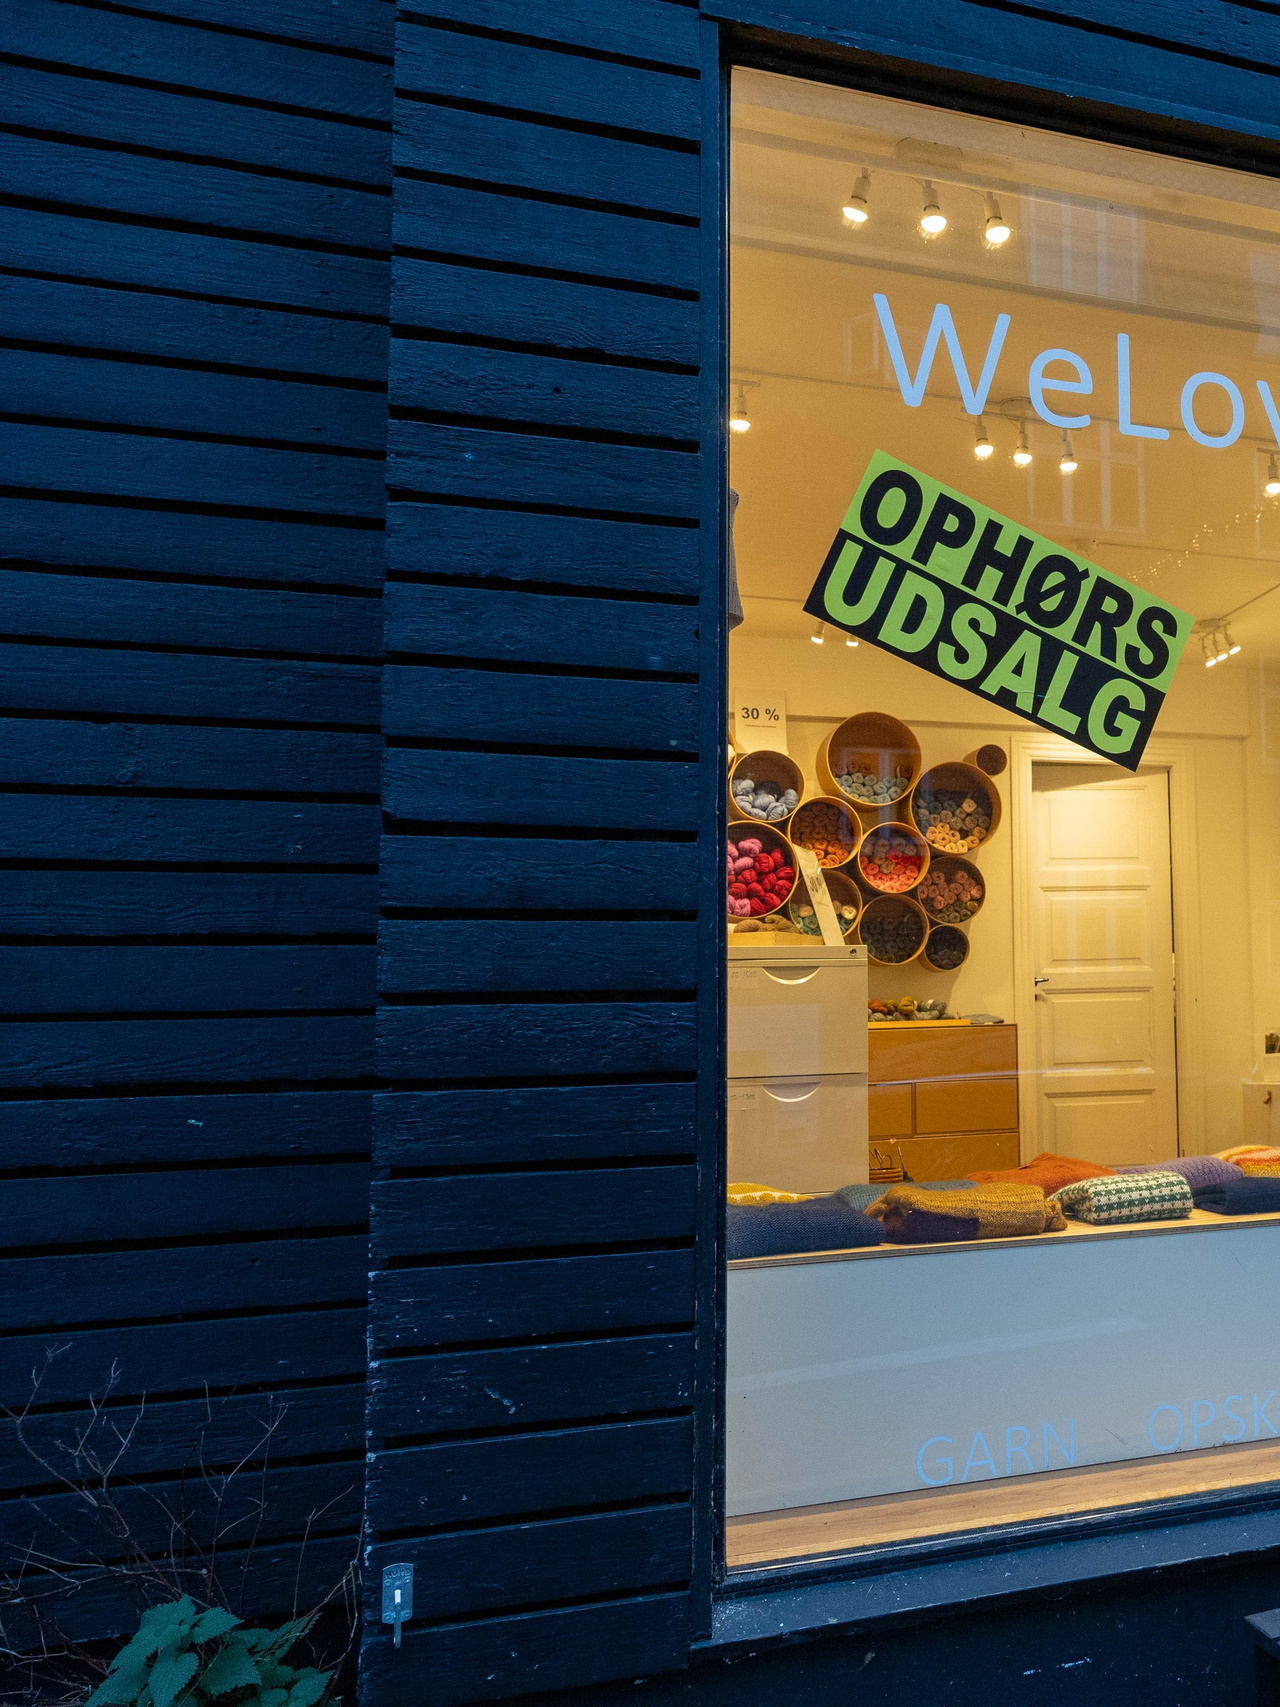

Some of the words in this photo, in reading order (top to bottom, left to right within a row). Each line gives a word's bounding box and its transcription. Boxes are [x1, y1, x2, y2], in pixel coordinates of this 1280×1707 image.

[860, 470, 1177, 679] OPHØRS
[741, 707, 760, 720] 30
[765, 708, 780, 721] %
[824, 539, 1146, 754] UDSALG
[917, 1419, 1077, 1485] GARN
